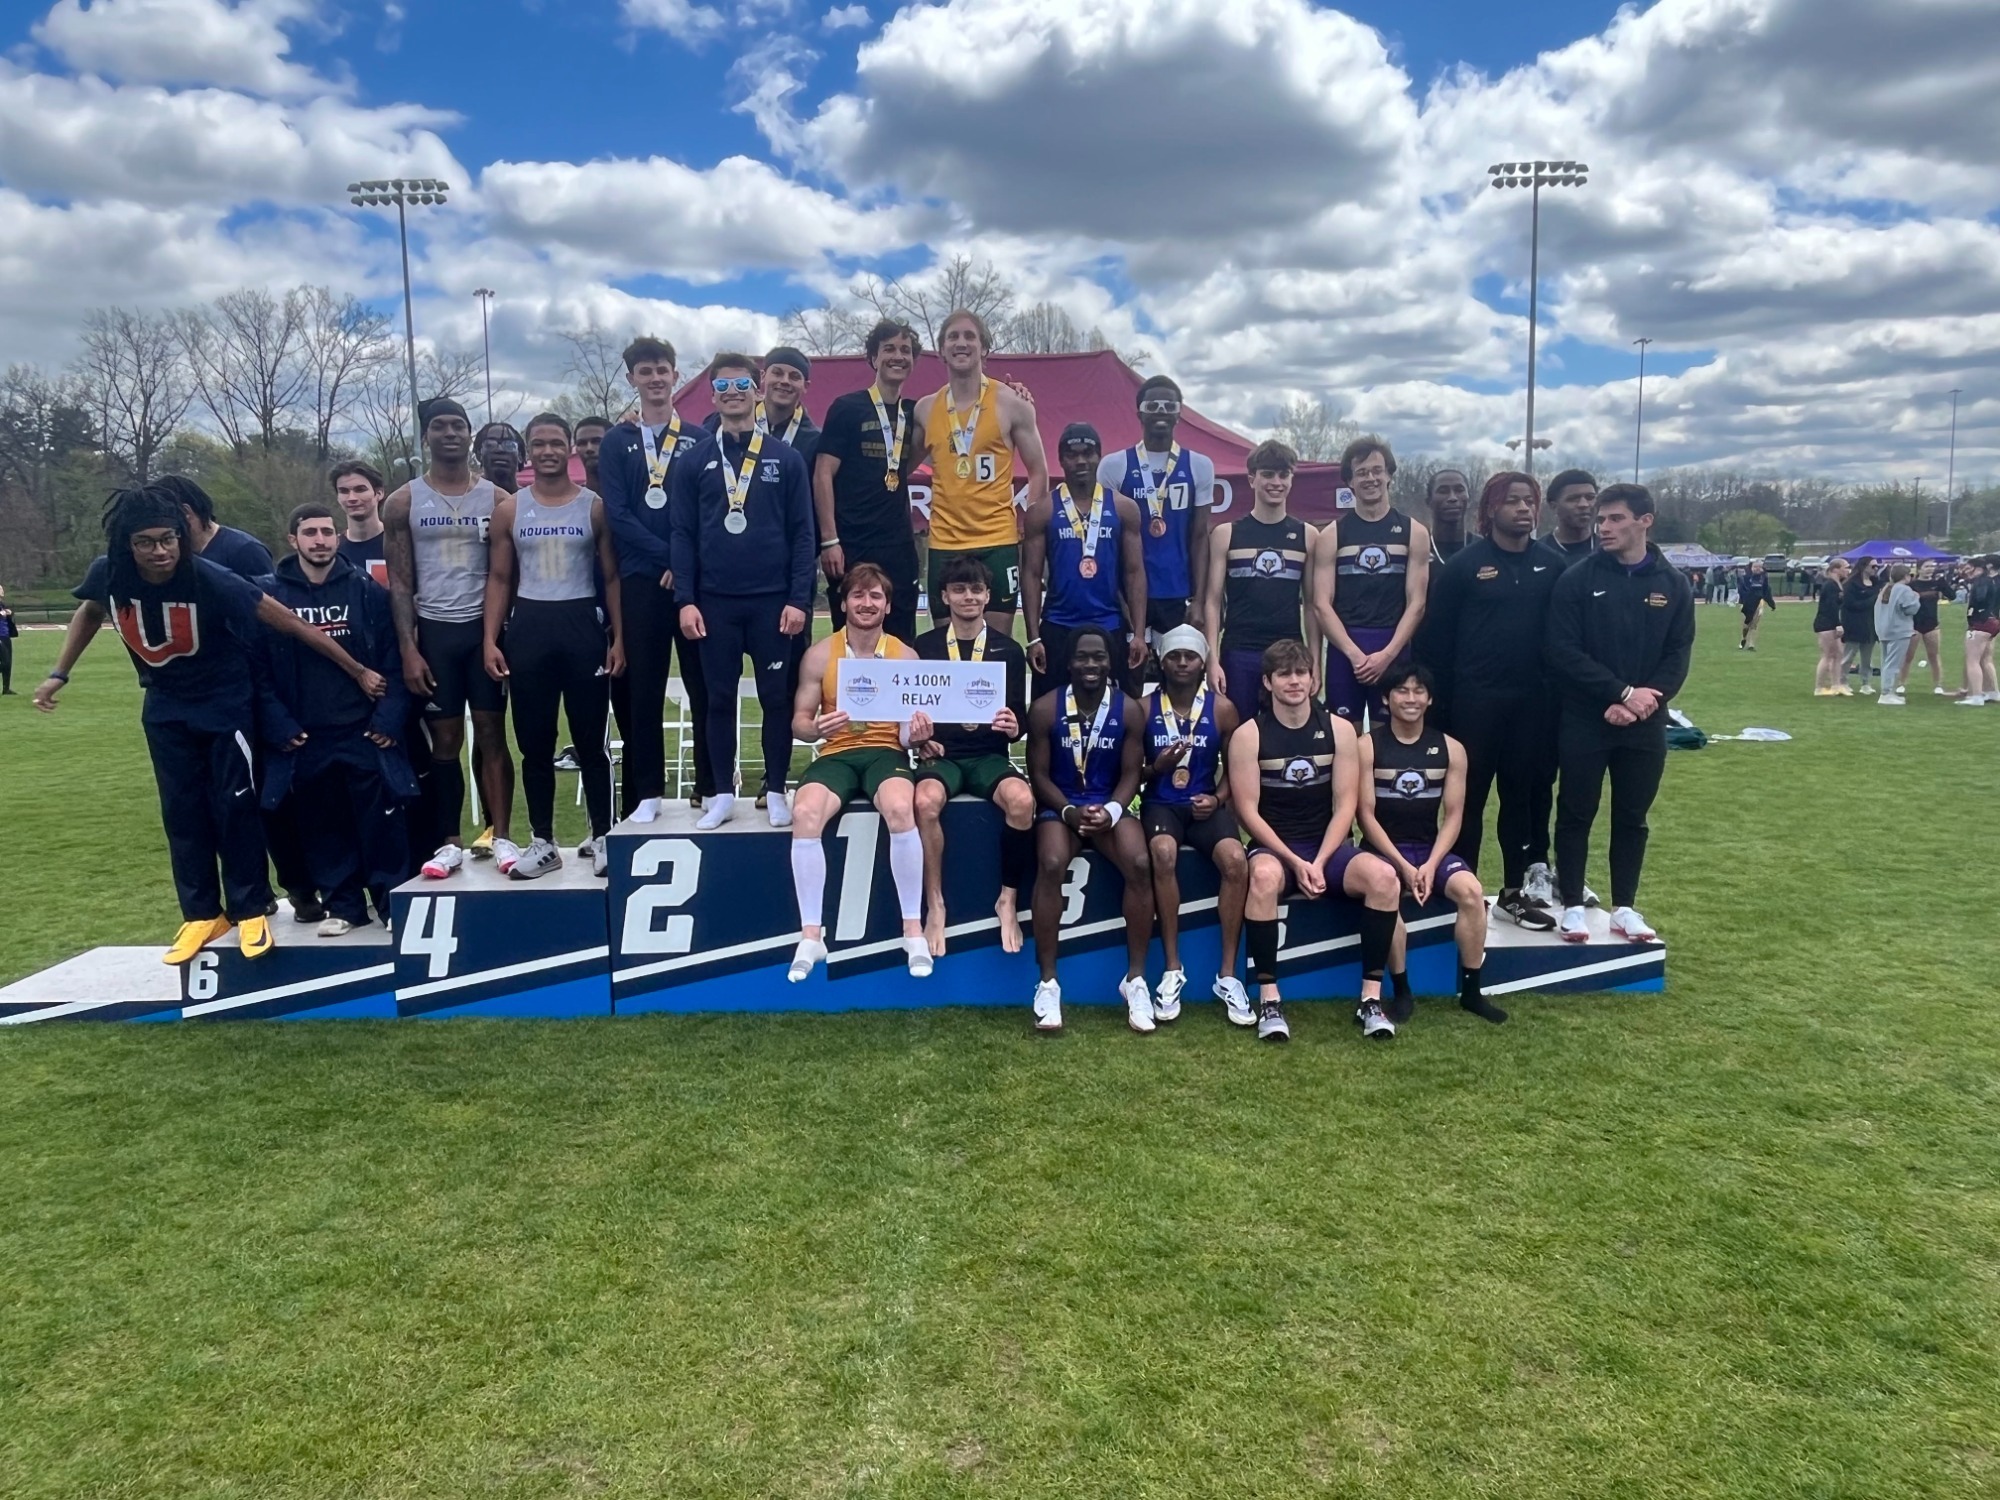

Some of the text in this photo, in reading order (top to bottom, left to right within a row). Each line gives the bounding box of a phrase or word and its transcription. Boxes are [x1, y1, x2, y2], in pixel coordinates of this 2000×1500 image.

[980, 456, 991, 480] 5
[1173, 485, 1185, 508] 7
[420, 516, 479, 527] HOUGTO
[519, 526, 585, 539] HOUGHTON
[1058, 526, 1113, 540] HACK
[109, 594, 200, 668] U
[892, 673, 951, 687] 4 x 100M
[901, 692, 942, 706] RELAY
[1061, 735, 1116, 750] HATICK
[835, 811, 881, 942] 1
[620, 838, 703, 955] 2
[1060, 856, 1091, 925] 3
[400, 895, 459, 978] 4
[187, 950, 219, 1000] 6
